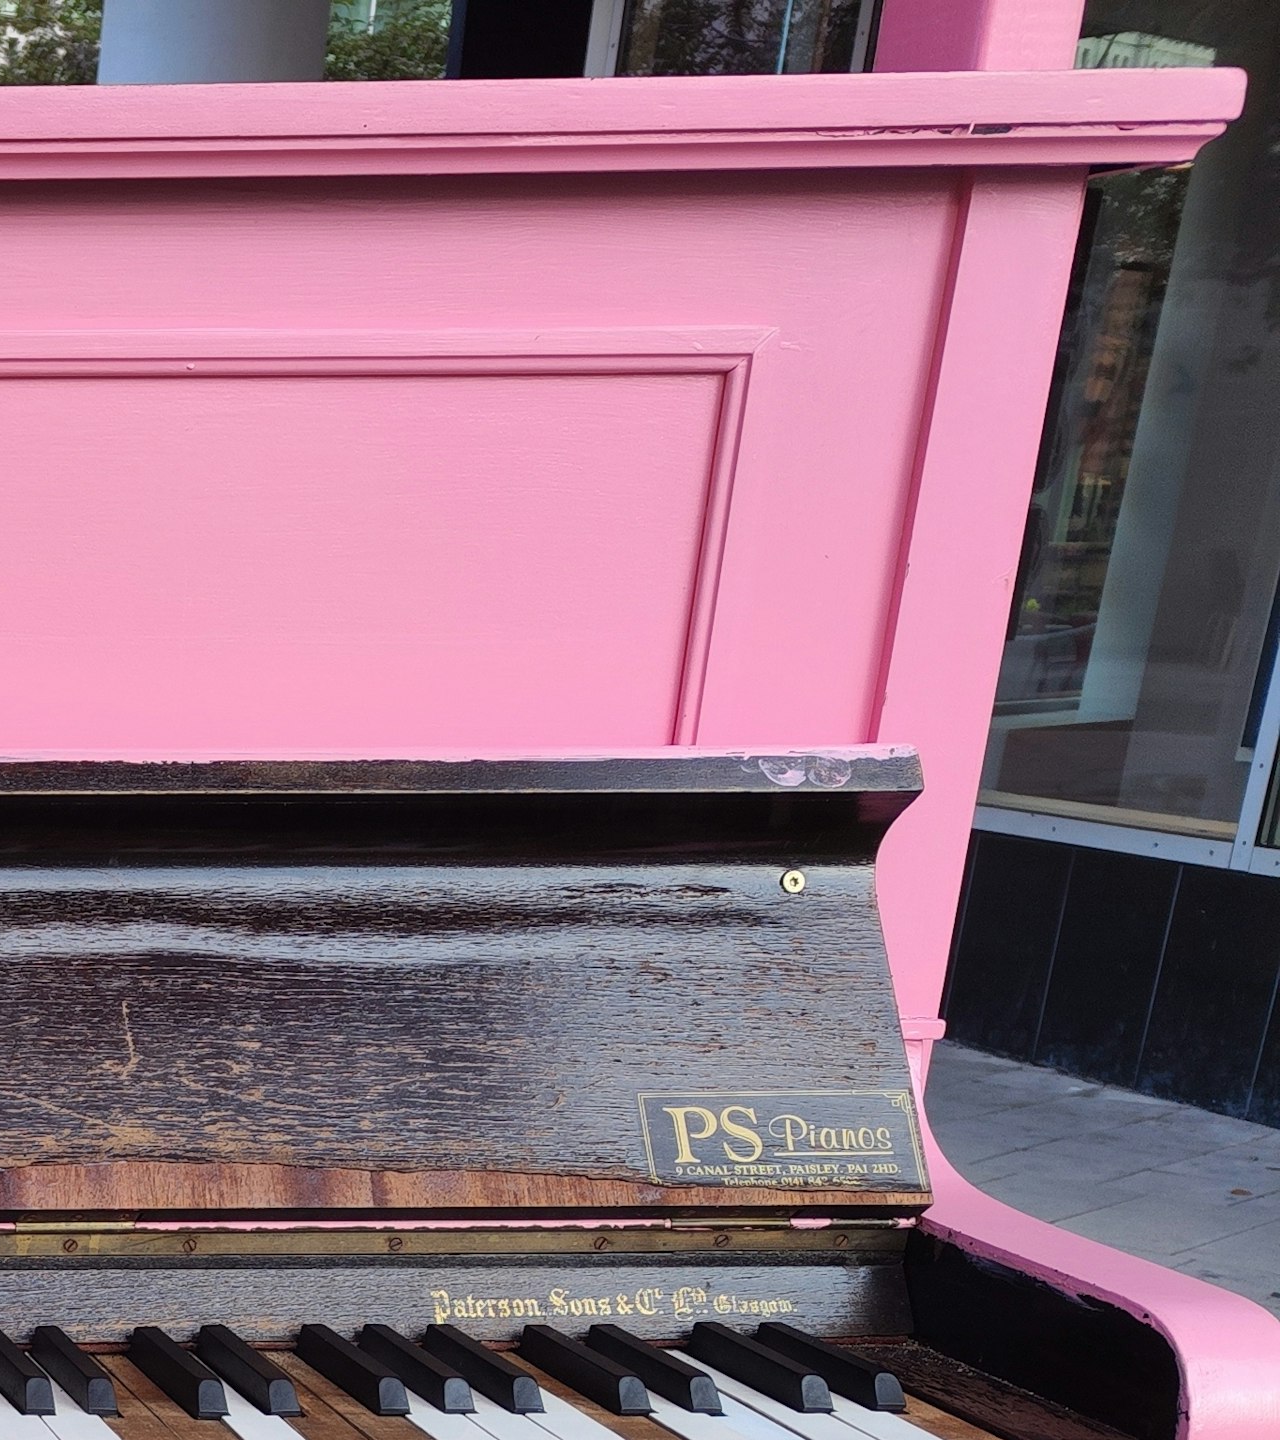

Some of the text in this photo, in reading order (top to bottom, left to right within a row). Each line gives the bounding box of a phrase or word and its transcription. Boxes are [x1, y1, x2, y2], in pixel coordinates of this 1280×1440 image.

[662, 1106, 894, 1165] PS Pianos
[675, 1166, 683, 1177] 9
[687, 1165, 732, 1176] CANAL
[734, 1164, 787, 1177] STREET,
[872, 1162, 902, 1174] 2HD.
[721, 1176, 778, 1187] Telephone
[781, 1176, 804, 1186] 0141
[616, 1293, 634, 1315] &
